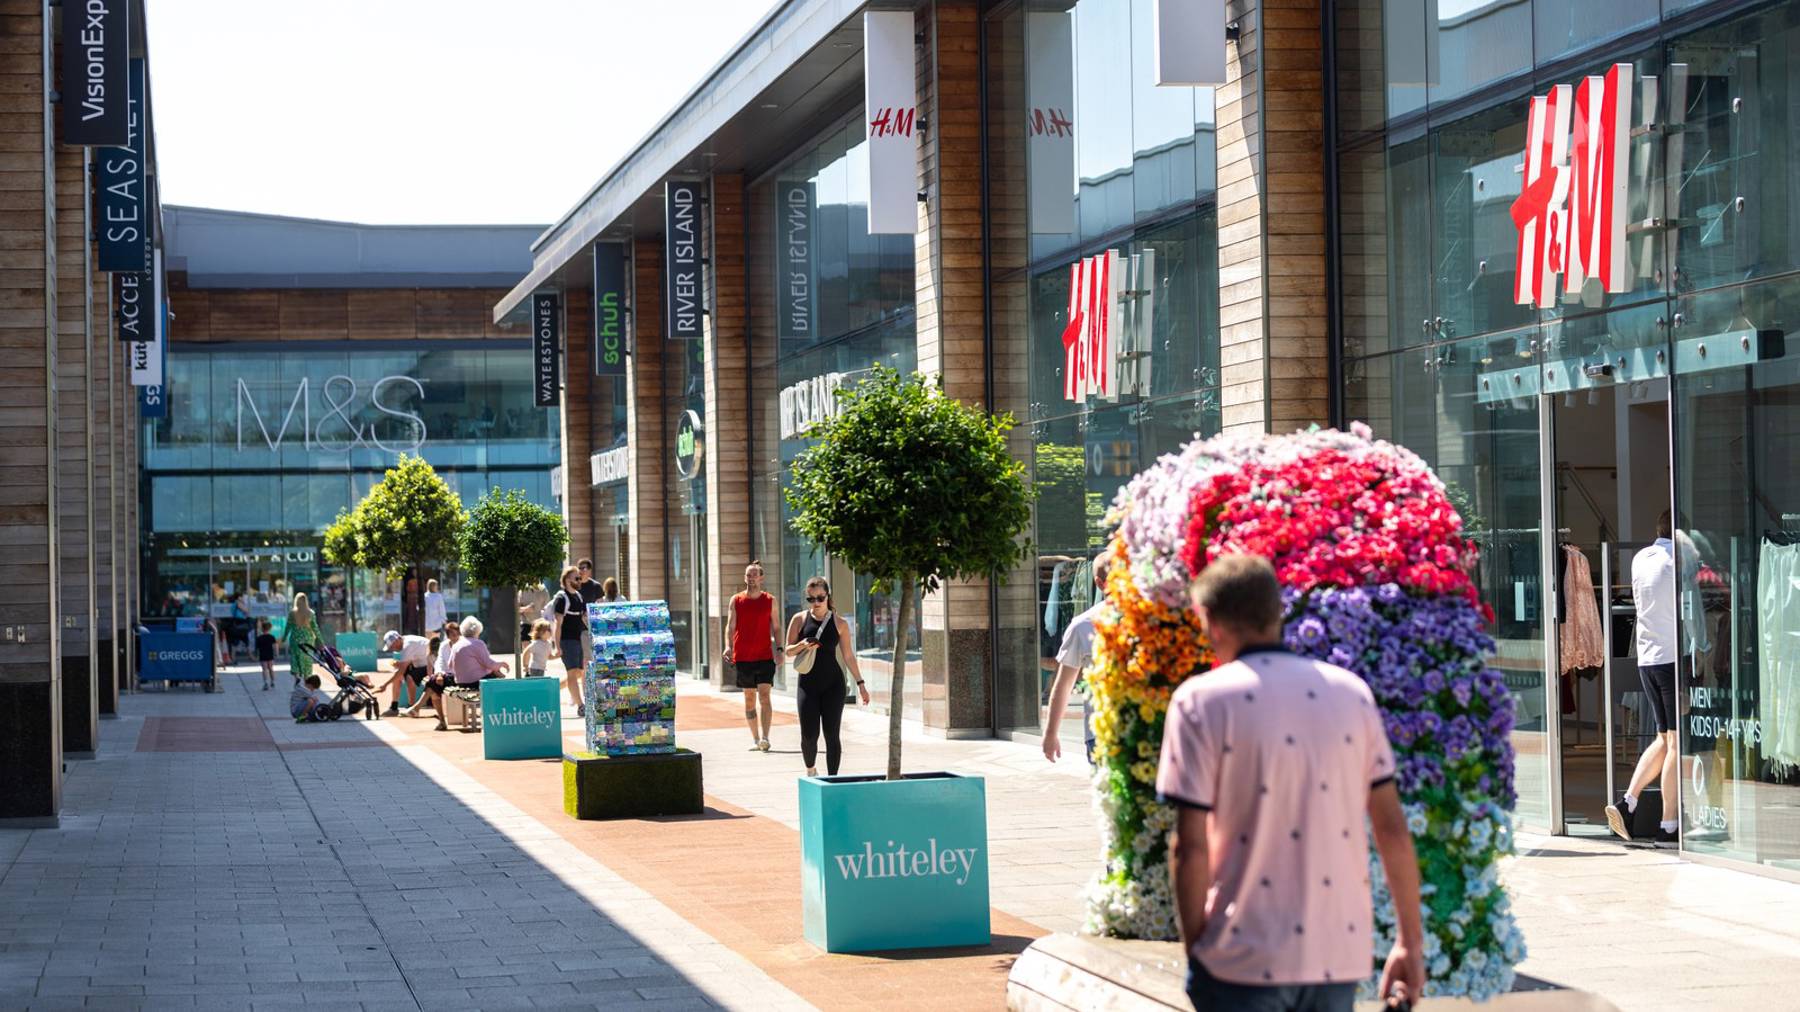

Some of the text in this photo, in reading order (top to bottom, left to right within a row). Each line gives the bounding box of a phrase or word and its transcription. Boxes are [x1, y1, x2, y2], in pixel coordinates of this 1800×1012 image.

[870, 107, 915, 138] H&M
[1509, 63, 1632, 308] H&M
[675, 188, 696, 331] RIVER ISLAND
[121, 271, 140, 335] ACCE
[600, 291, 619, 365] schuh
[1061, 249, 1119, 403] H&M
[541, 299, 553, 402] WATERSTONES
[237, 375, 427, 452] M&S
[159, 650, 204, 661] GREGGS
[488, 705, 556, 728] whiteley
[1689, 686, 1711, 708] MEN
[1690, 715, 1712, 738] KIDS
[1692, 805, 1728, 830] LADIES
[834, 838, 978, 886] whiteley
